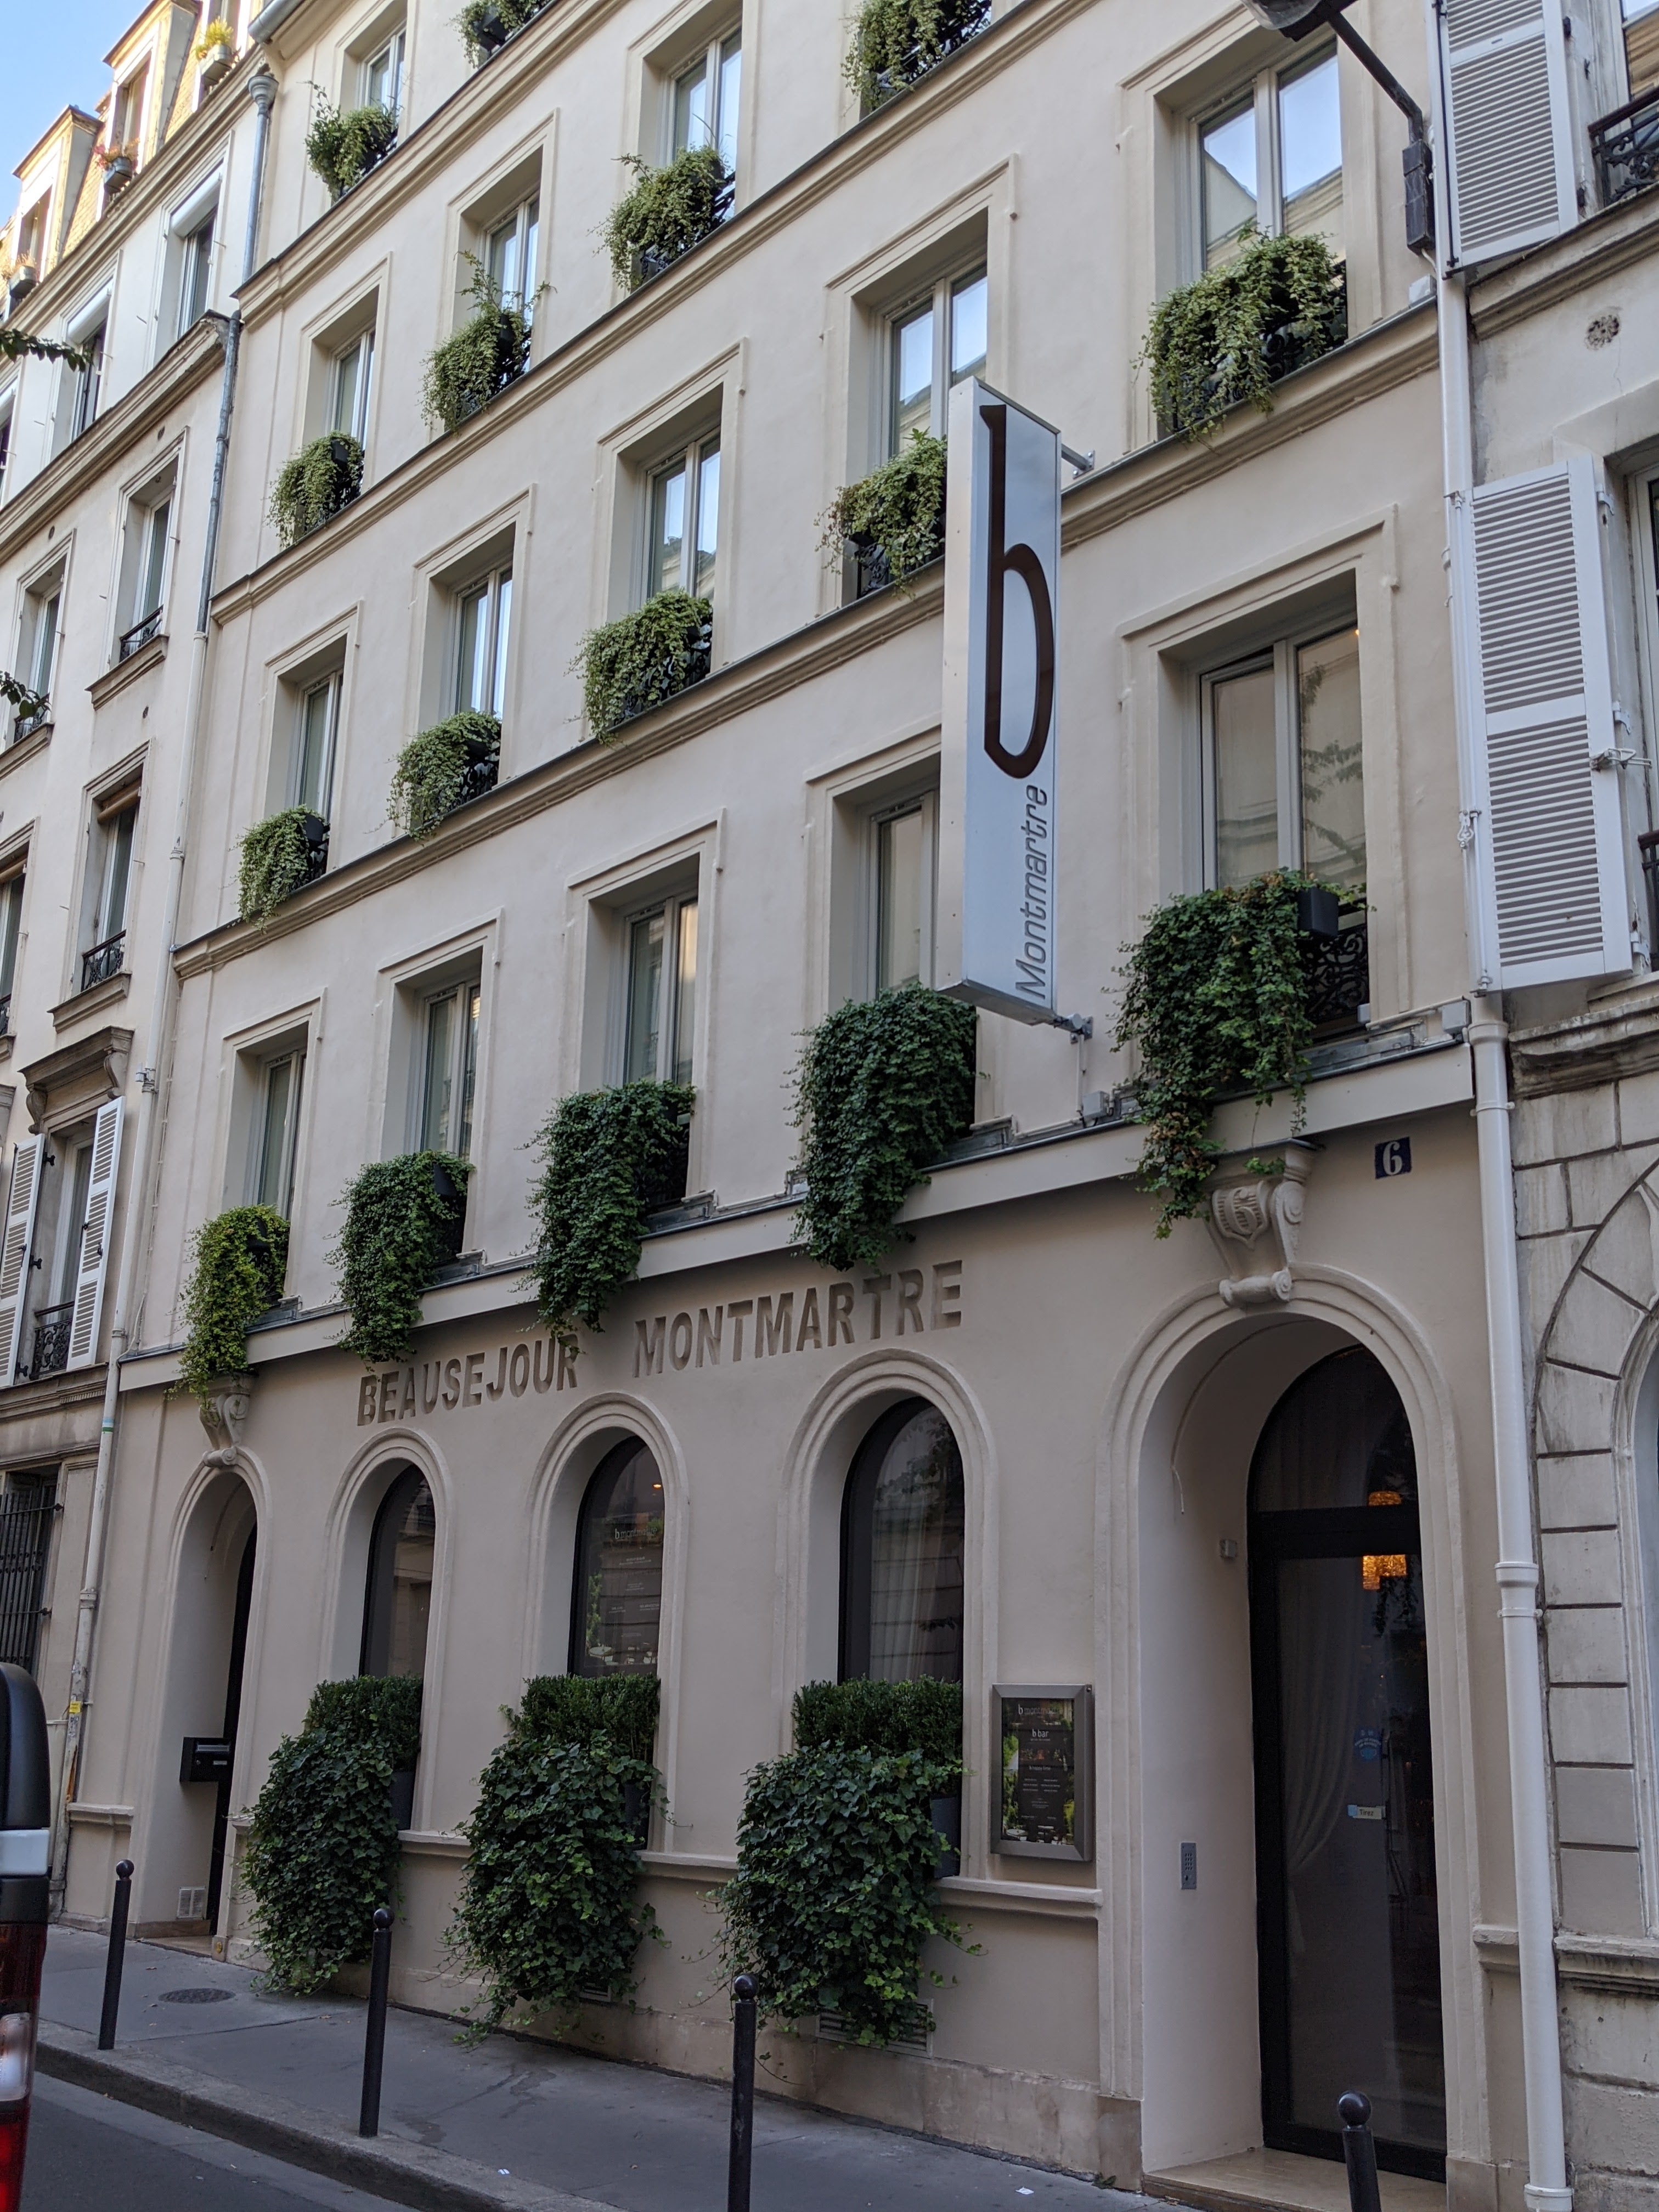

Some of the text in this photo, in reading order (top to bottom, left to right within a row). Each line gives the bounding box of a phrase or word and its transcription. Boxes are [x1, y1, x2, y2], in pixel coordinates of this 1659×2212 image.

[979, 404, 1054, 779] b
[1015, 784, 1048, 1000] Montmartre
[1383, 1141, 1403, 1176] 6
[357, 1260, 963, 1426] BEAUSEJOUR MONTMARTRE
[1018, 1703, 1060, 1715] b montma
[1032, 1729, 1049, 1737] b bar
